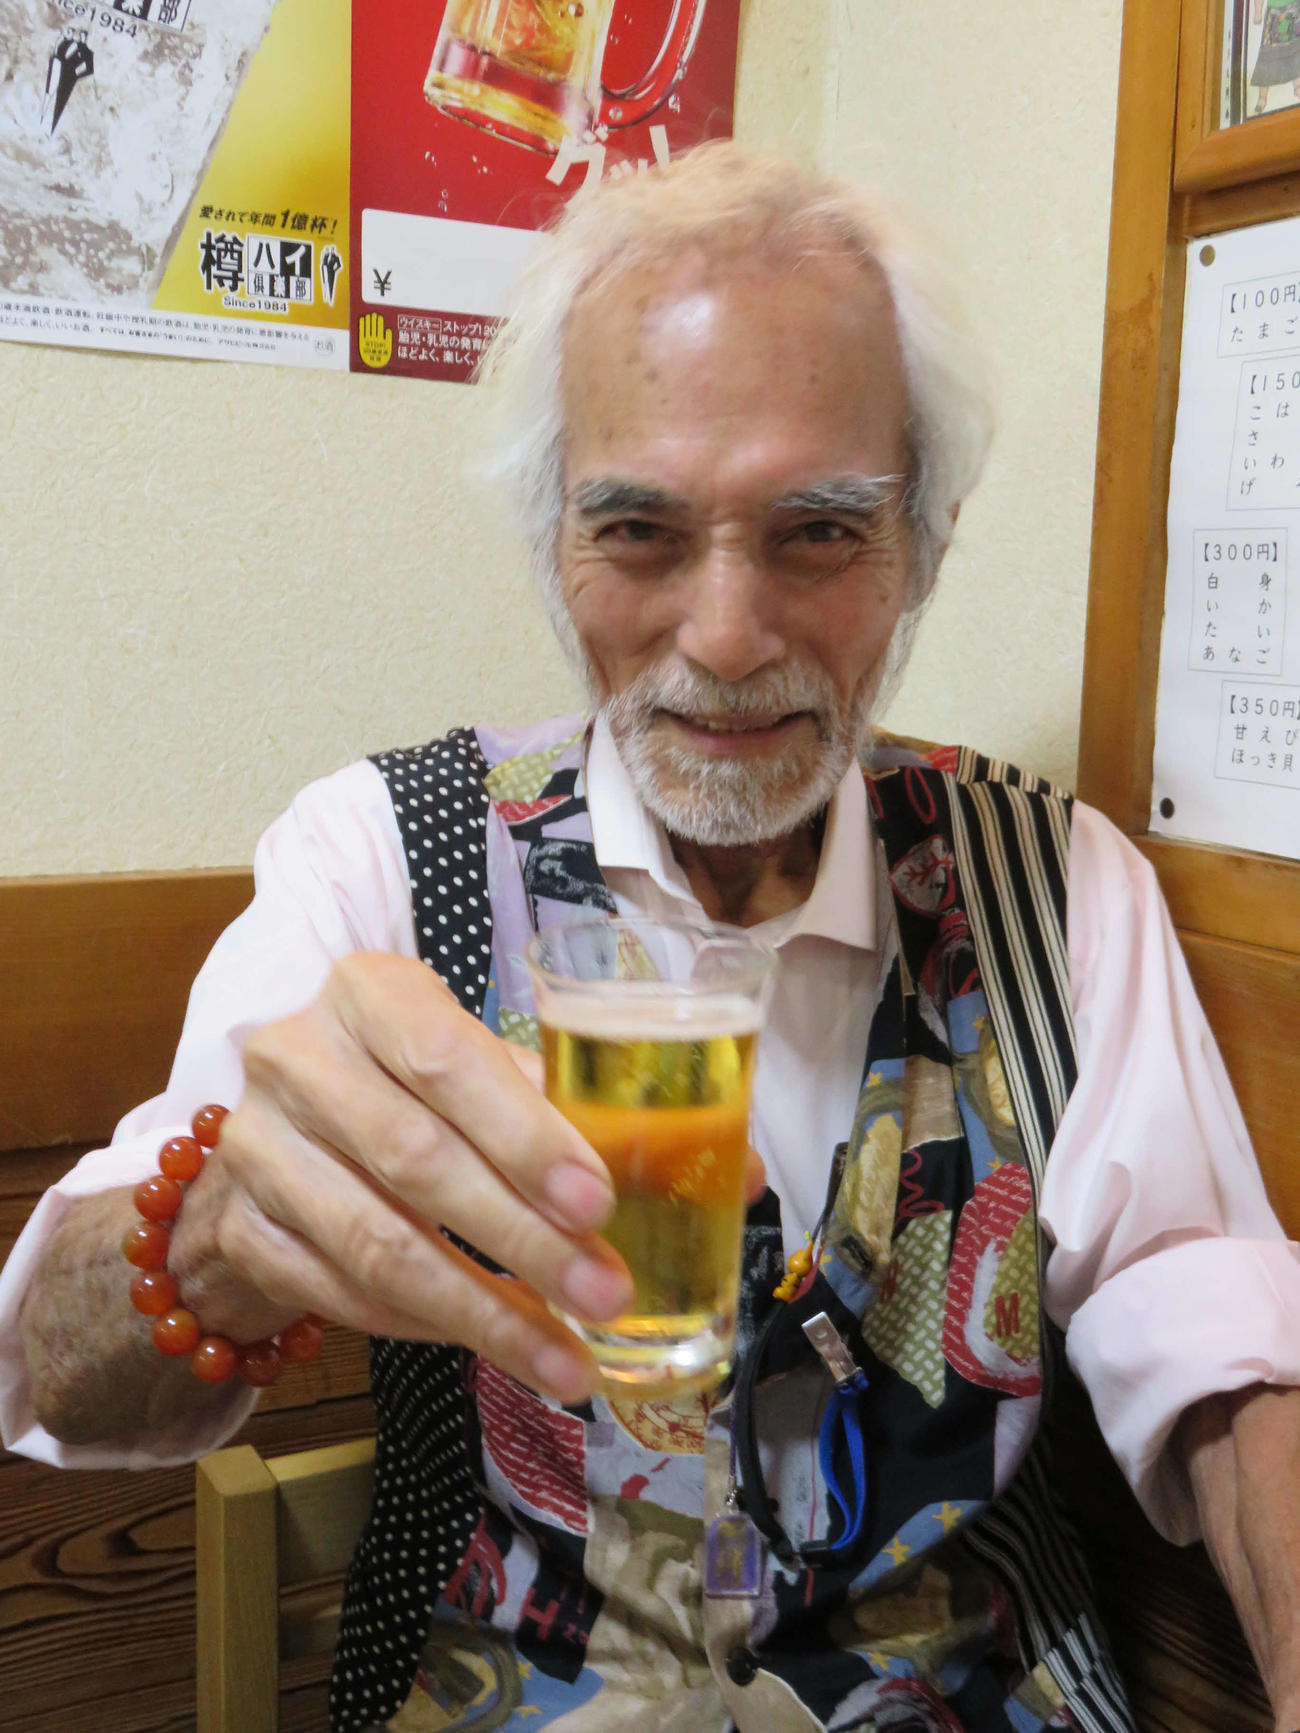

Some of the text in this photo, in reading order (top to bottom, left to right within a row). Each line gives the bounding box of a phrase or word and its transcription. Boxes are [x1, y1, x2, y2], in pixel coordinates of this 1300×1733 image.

[57, 0, 138, 38] ce1984
[223, 296, 288, 313] Since1984
[1203, 541, 1278, 562] 【300円】
